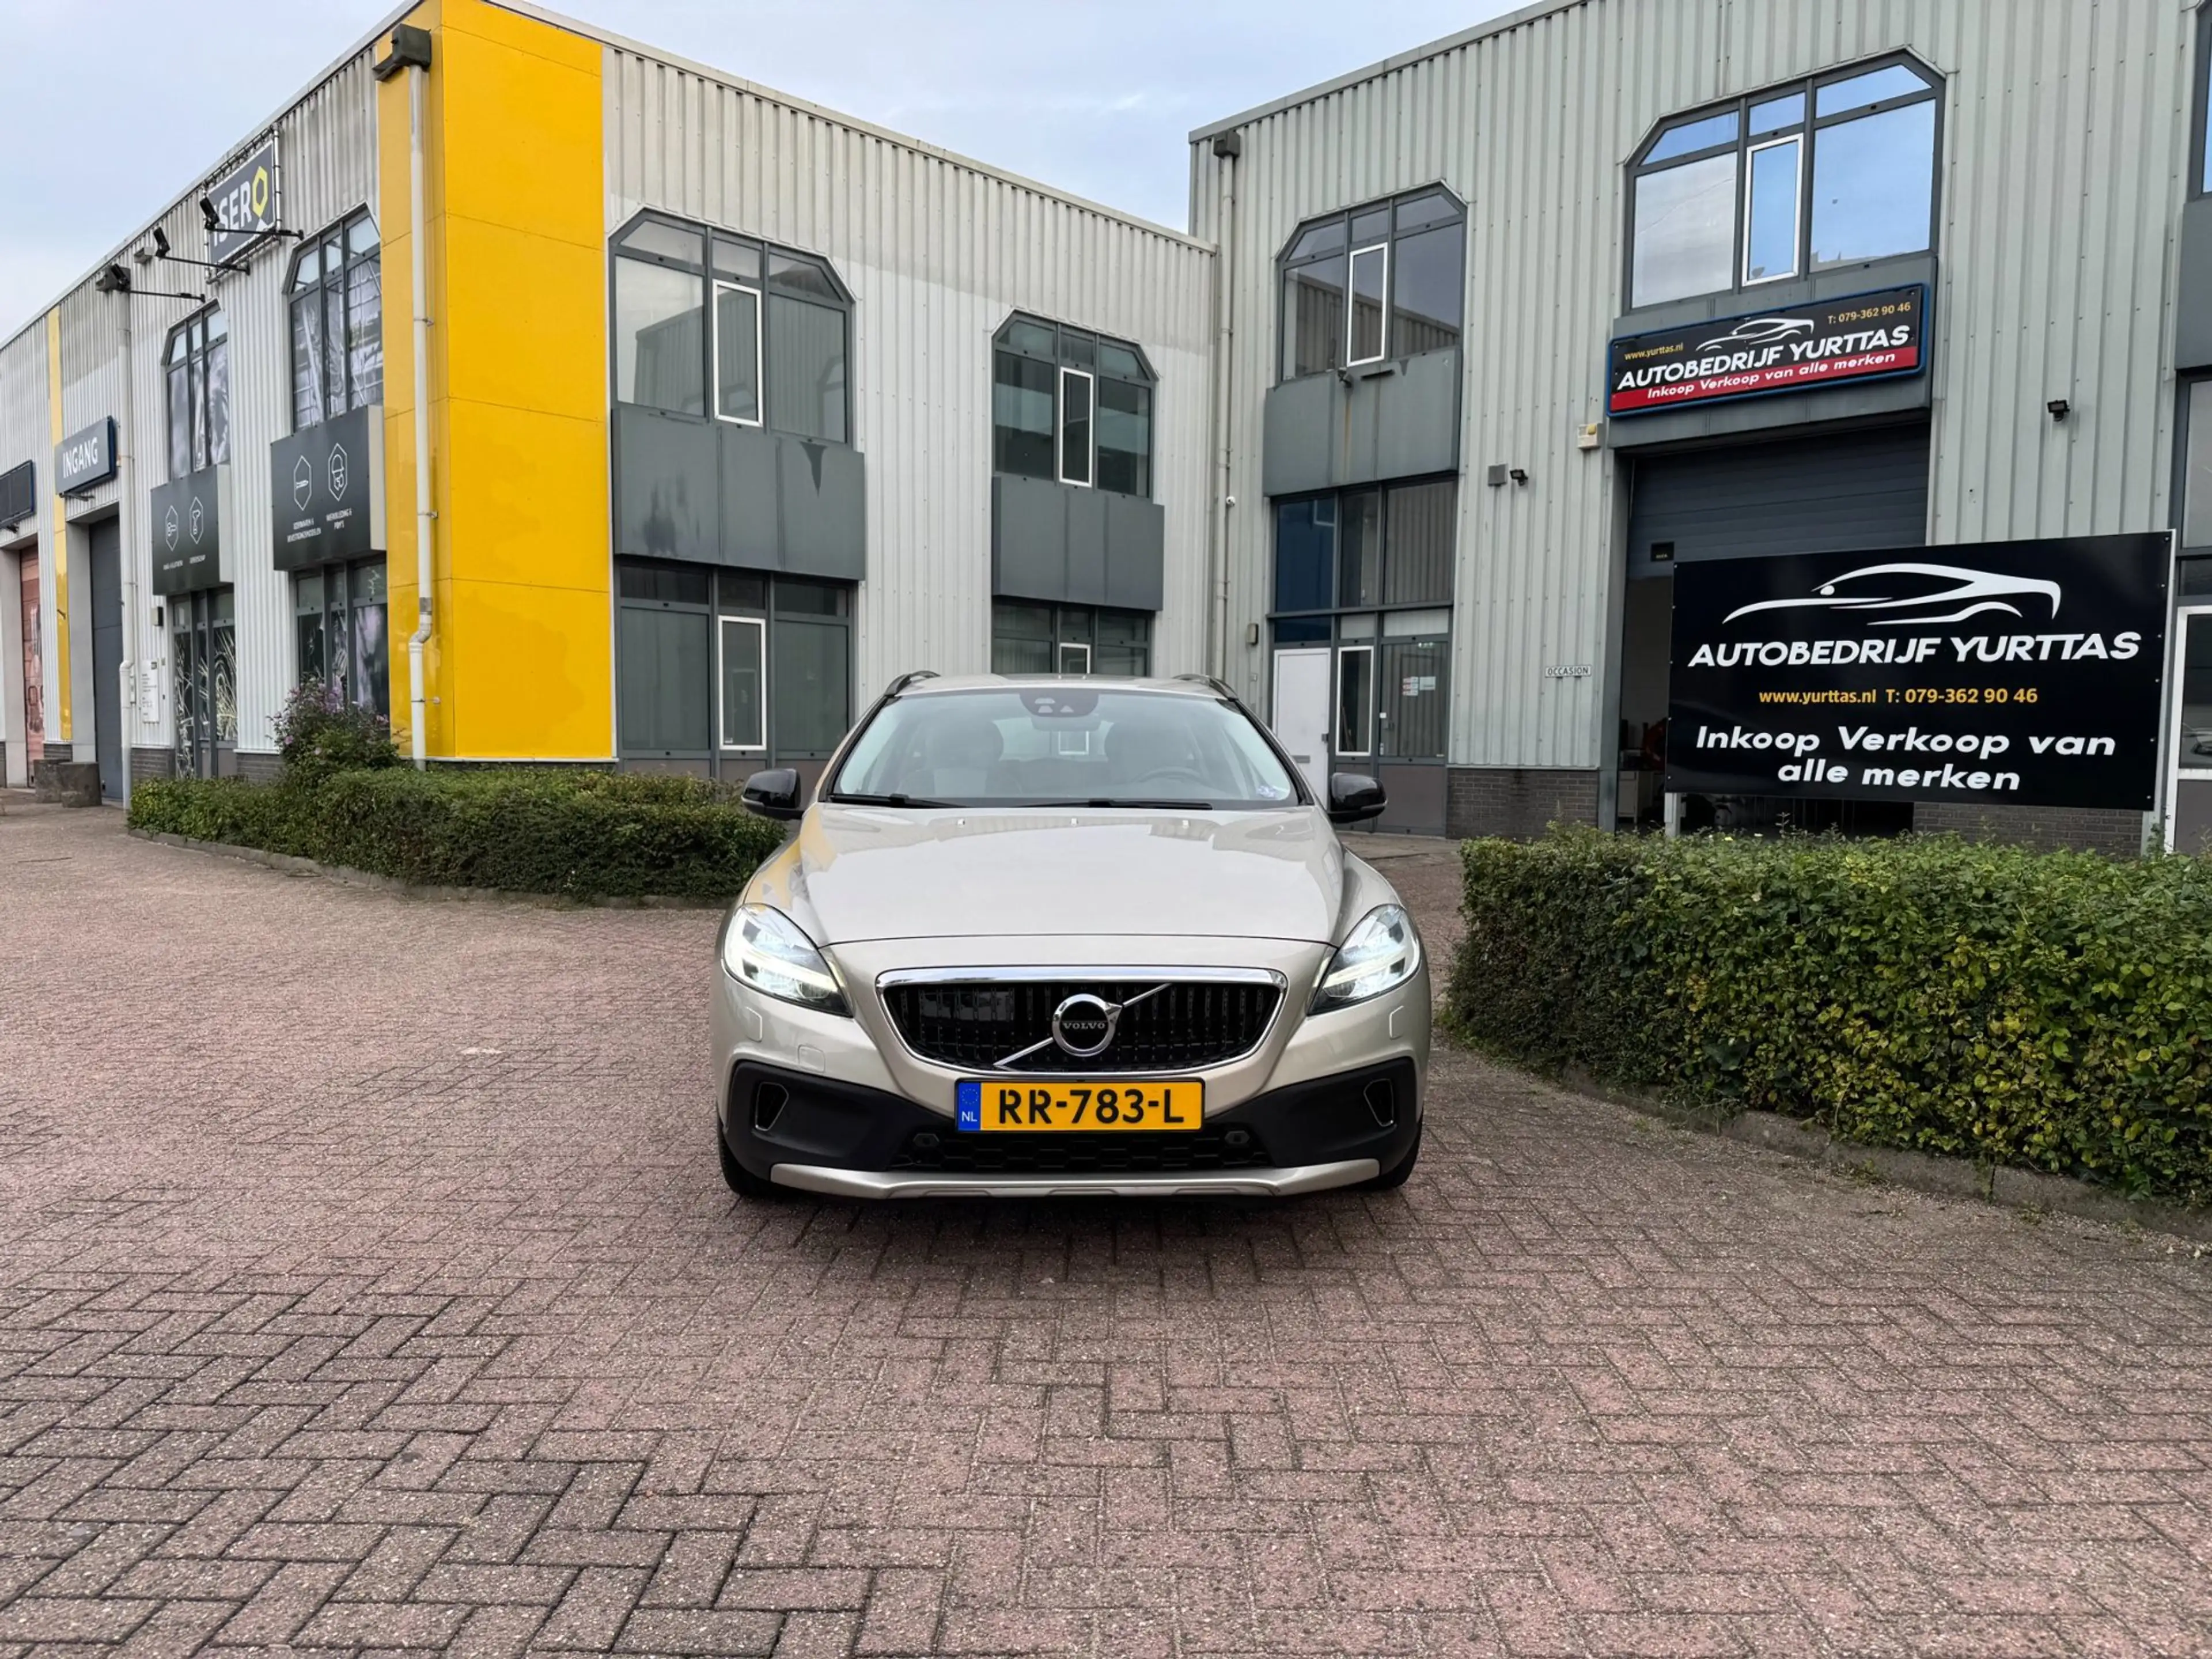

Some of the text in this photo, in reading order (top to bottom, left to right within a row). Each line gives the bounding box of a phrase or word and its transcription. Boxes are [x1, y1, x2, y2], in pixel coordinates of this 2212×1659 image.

[1828, 301, 1911, 324] T: 079-362 90 46
[1617, 324, 1910, 390] AUTOBEDRIJF YURTTAS
[1624, 342, 1684, 361] www.yurttas.nl
[1647, 353, 1895, 399] Inkoop Verkoop van alle merken
[62, 436, 99, 479] INGANG
[1688, 631, 2142, 667] AUTOBEDRIJF YURTTAS
[1547, 666, 1589, 676] OCCASION
[1759, 688, 2038, 704] www.yurttas.nl T: 079-362 90 46
[1696, 726, 2116, 759] Inkoop Verkoop van
[1778, 759, 2020, 790] alle merken
[1062, 1020, 1106, 1030] VOLVO
[961, 1089, 1184, 1123] NL RR-783-L
